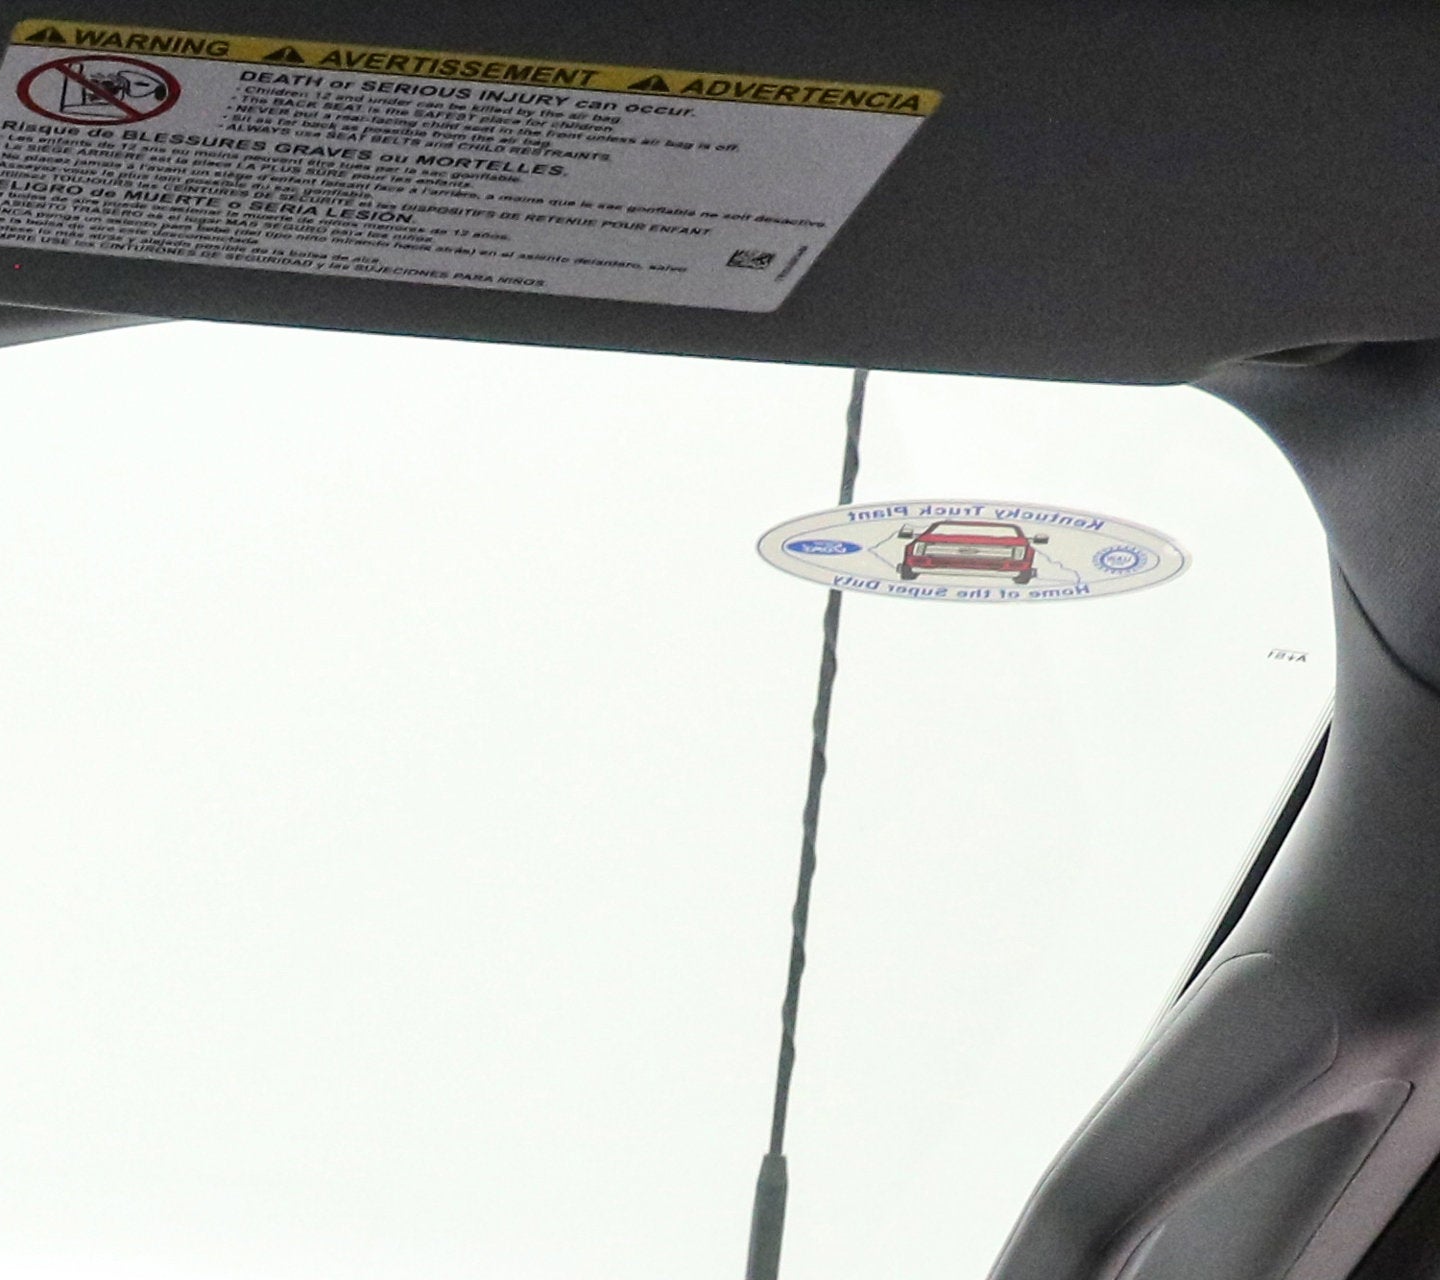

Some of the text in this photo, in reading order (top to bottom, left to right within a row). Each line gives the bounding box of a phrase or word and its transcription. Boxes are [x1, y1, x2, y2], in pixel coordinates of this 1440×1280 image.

[71, 29, 233, 56] WARNING
[320, 49, 599, 86] AVERTISSEMENT
[238, 70, 700, 118] DEATH or SERIOUS INJURY can occur.
[681, 78, 920, 111] ADVERTENCIA
[0, 119, 573, 177] Risque de BLESSURES GRAVES ou MORTELLES.
[89, 187, 118, 198] de
[123, 190, 223, 207] MUERTE
[226, 200, 242, 209] o
[248, 200, 320, 215] SERIA
